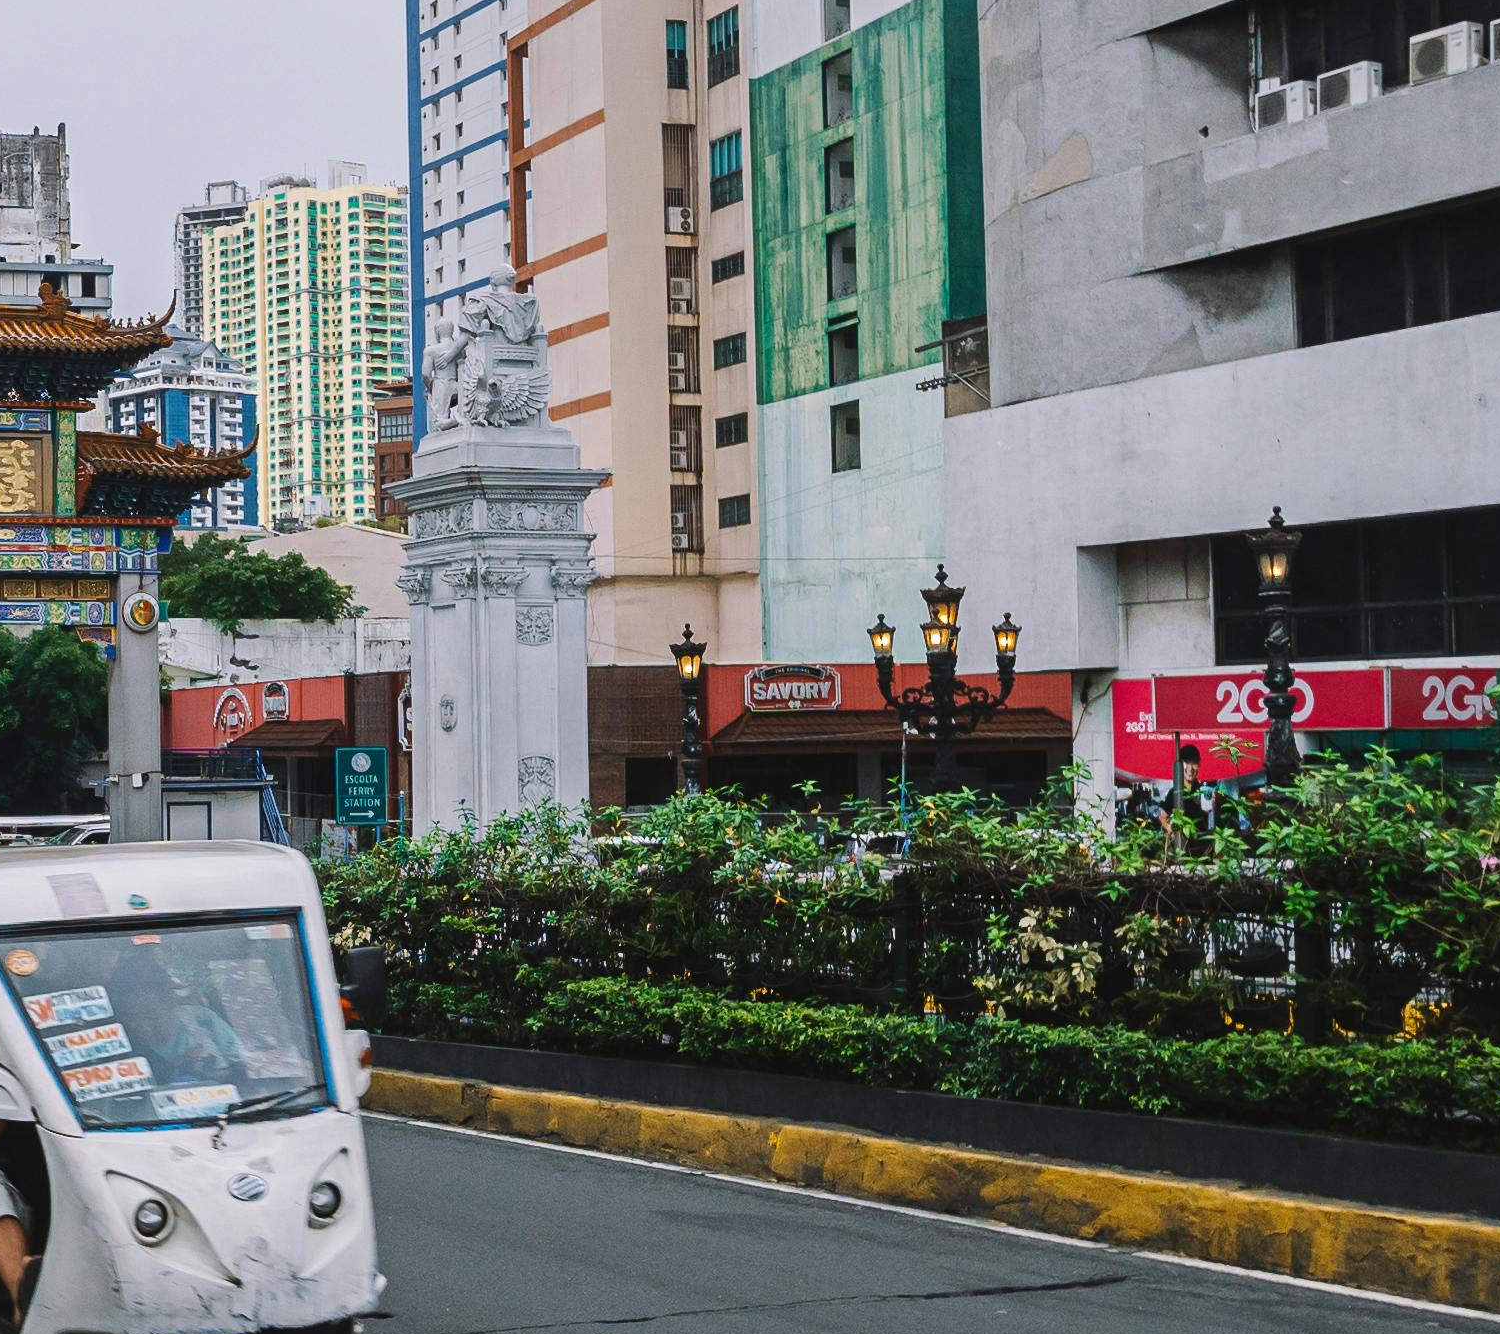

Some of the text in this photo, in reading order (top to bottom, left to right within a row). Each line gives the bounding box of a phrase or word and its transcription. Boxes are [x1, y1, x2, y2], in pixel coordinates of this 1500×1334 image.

[753, 682, 832, 700] SAVORY
[1217, 679, 1315, 724] 2GO
[345, 775, 378, 784] ESCOLTA
[348, 787, 375, 796] FERRY
[344, 798, 381, 808] STATION
[61, 1061, 145, 1087] PEDRO GIL
